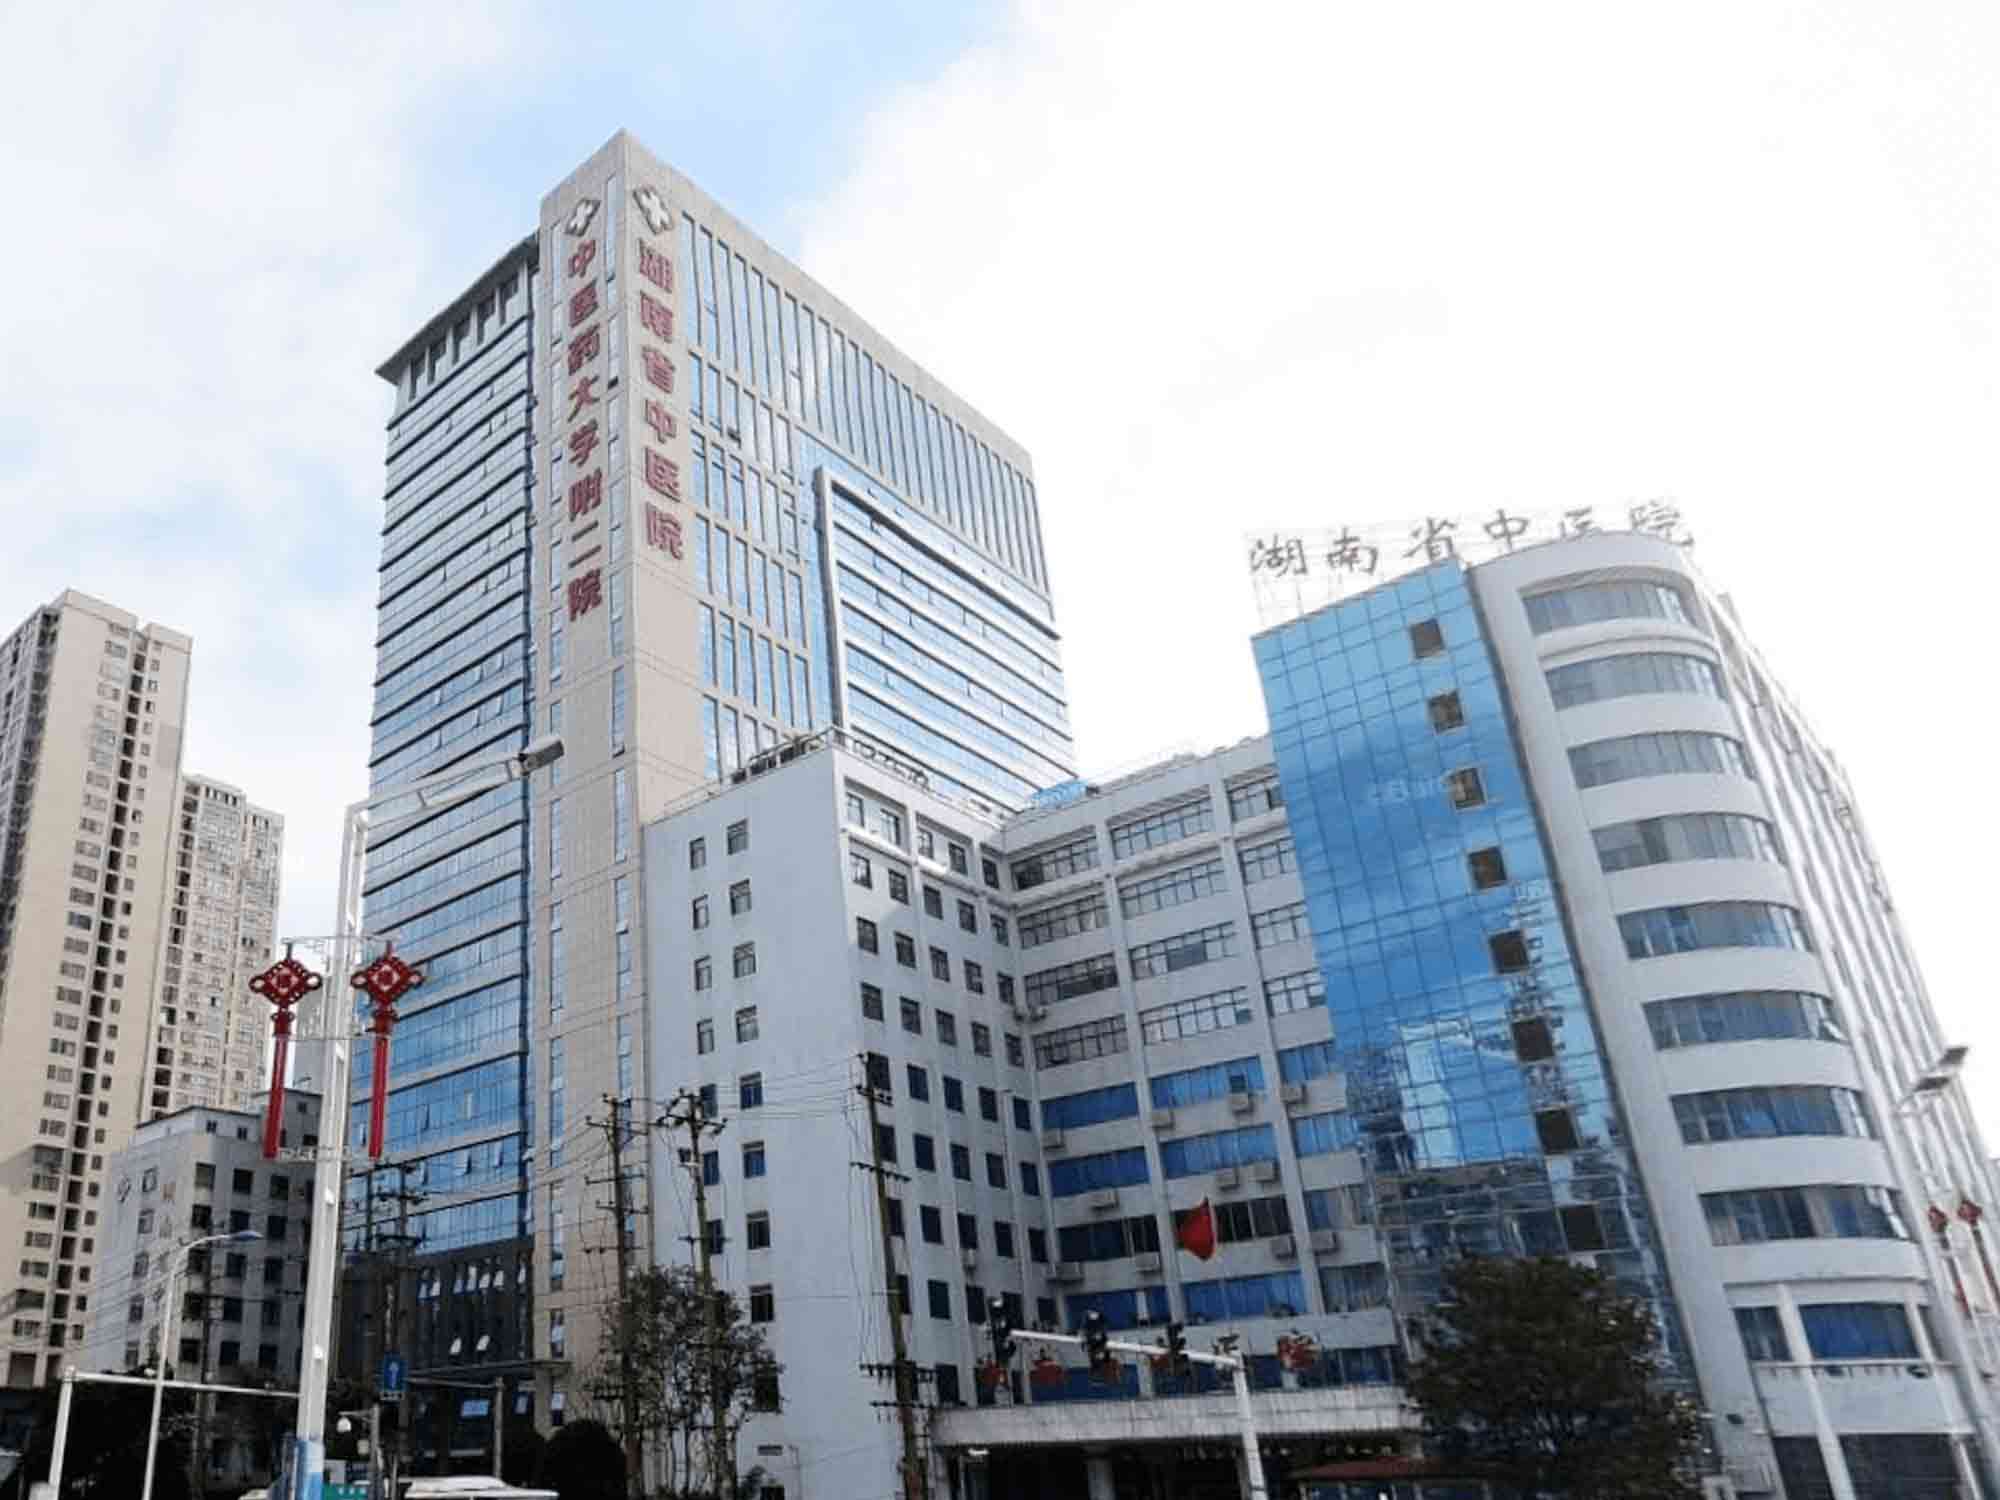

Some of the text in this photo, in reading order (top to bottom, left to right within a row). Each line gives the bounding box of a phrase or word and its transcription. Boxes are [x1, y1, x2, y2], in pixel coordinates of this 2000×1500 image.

[568, 239, 602, 622] 中医药大学附二院
[639, 237, 683, 560] 湖南省中医院
